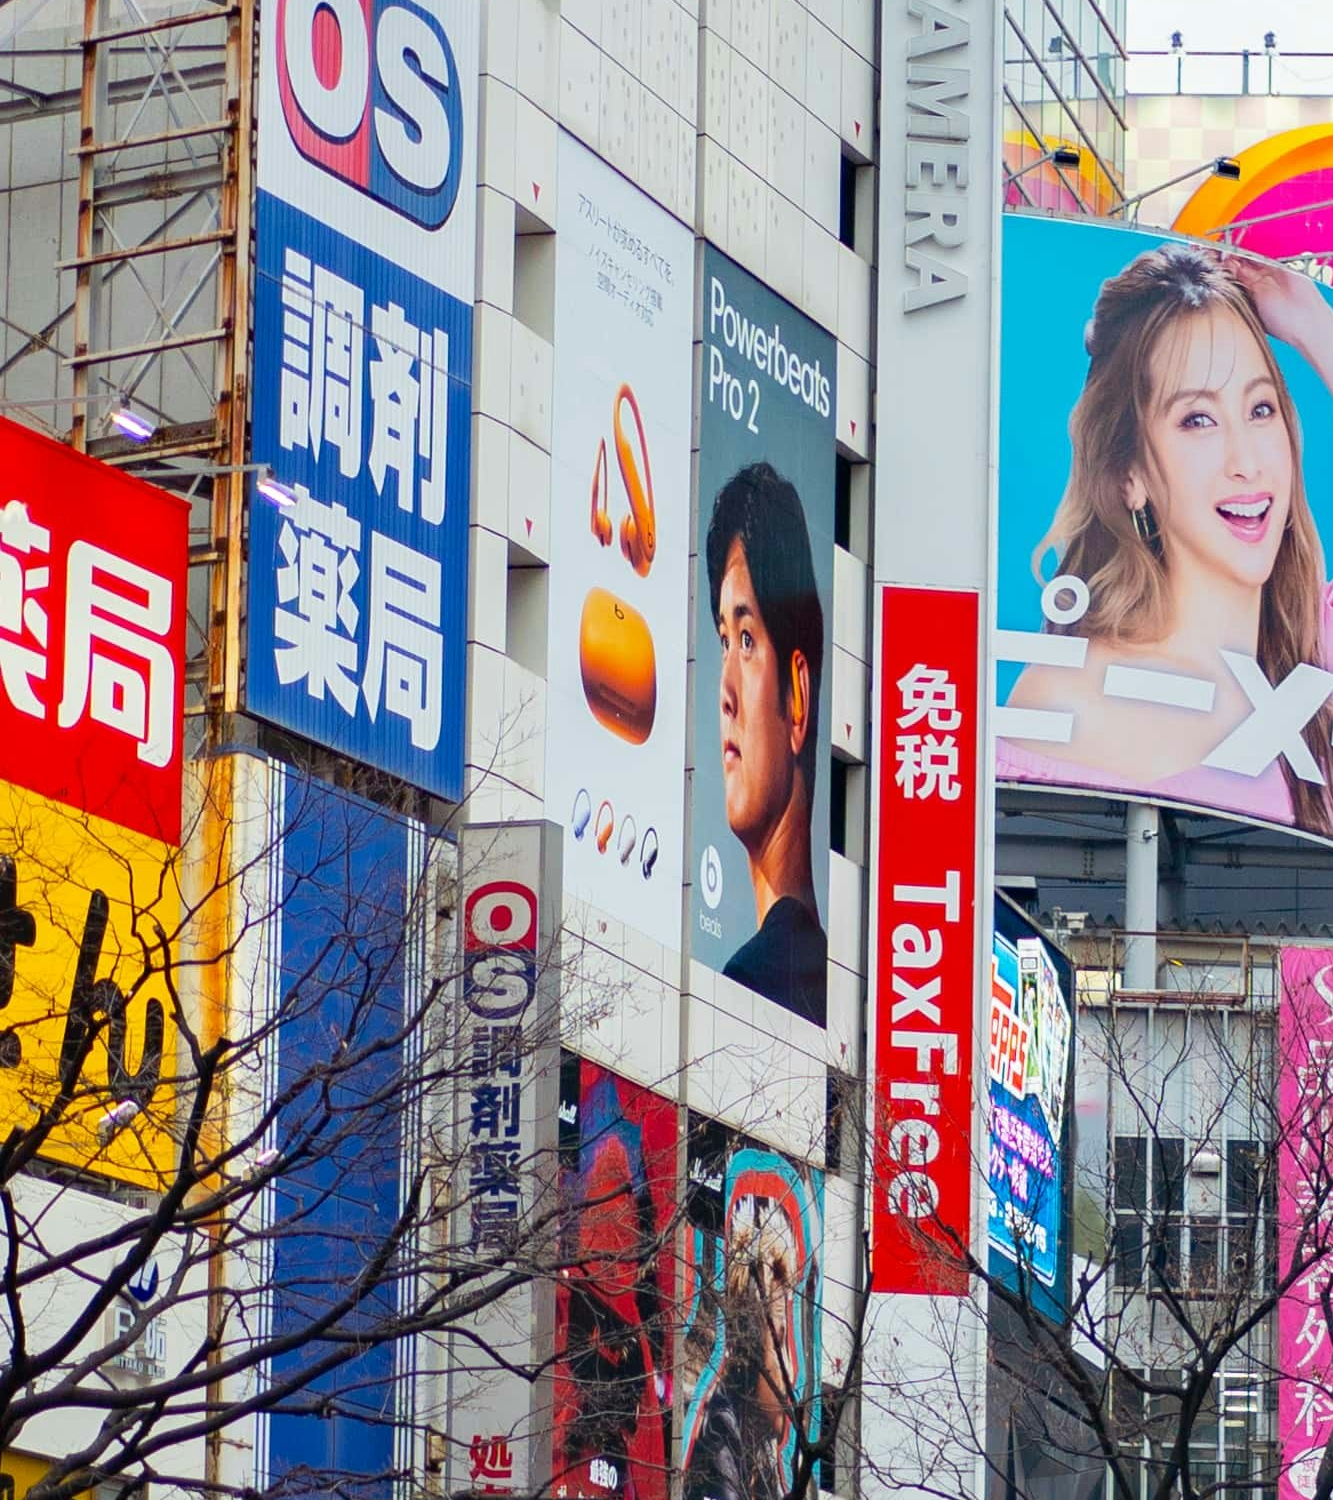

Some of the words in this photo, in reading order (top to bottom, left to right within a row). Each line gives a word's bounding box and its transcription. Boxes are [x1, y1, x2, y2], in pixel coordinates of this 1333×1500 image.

[280, 246, 450, 526] 調剤
[709, 344, 743, 420] Pro
[747, 378, 760, 435] 2
[710, 276, 831, 418] Powerbeats
[273, 484, 444, 752] 薬局
[895, 664, 963, 802] 免税
[698, 911, 724, 941] beats
